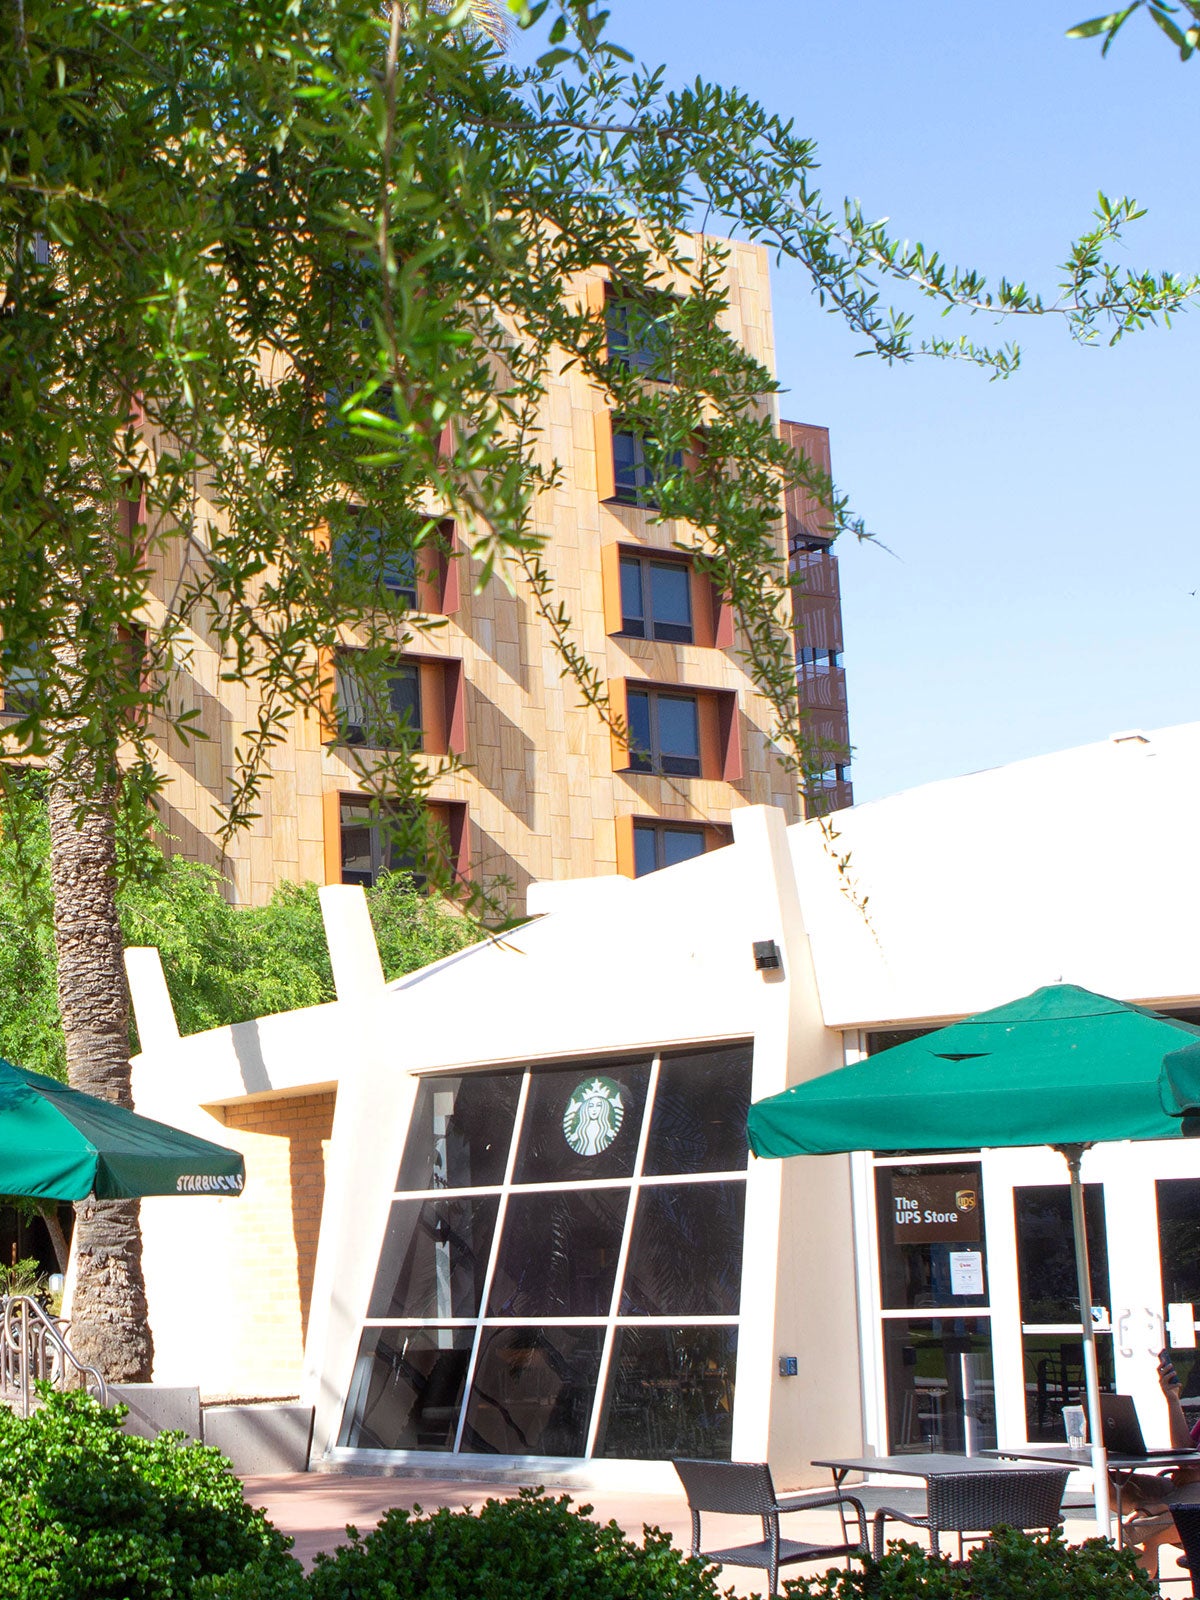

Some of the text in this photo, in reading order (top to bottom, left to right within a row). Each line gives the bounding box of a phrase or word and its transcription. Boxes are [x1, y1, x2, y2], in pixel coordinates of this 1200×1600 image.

[894, 1196, 919, 1210] The
[895, 1210, 958, 1224] UPS Store
